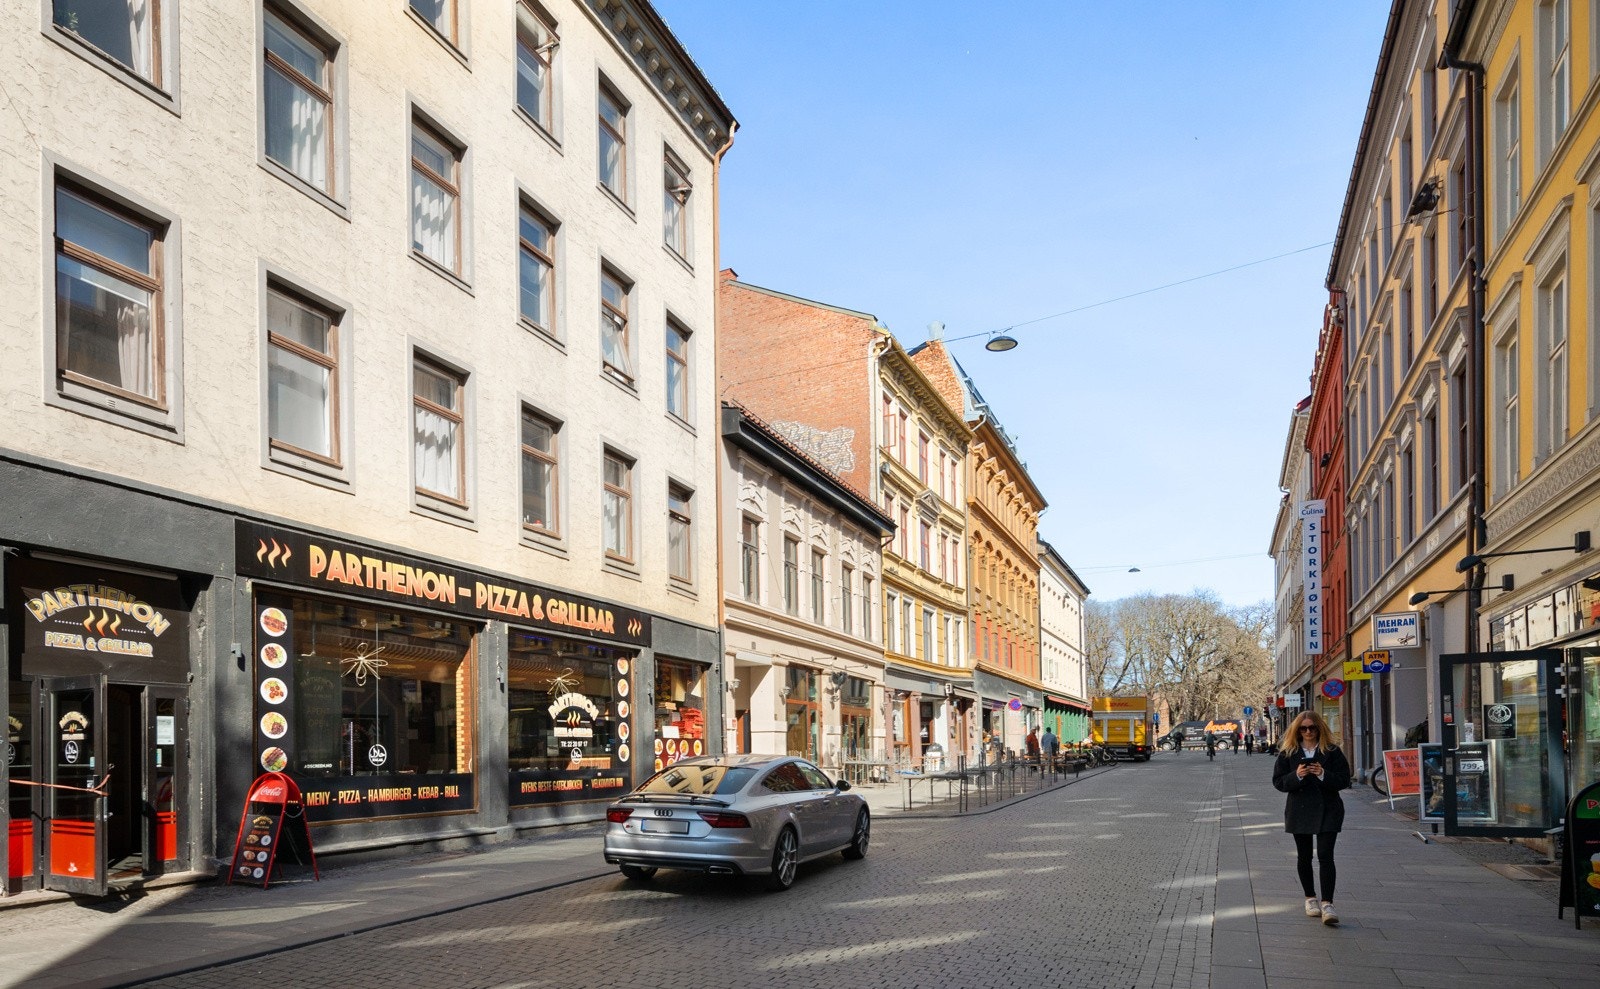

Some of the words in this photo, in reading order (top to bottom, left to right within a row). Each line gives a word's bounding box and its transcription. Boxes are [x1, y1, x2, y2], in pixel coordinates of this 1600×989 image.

[309, 544, 456, 604] PARTHENON
[476, 581, 530, 619] PIZZA
[532, 594, 545, 620] &
[546, 598, 615, 634] GRILLBAR
[1308, 522, 1319, 649] STORKJØKKEN
[25, 584, 171, 637] PARTHENON
[1378, 617, 1415, 628] MEHRAN
[45, 631, 85, 650] PIZZA
[86, 637, 98, 651] &
[98, 638, 153, 657] GRILLBAR
[1368, 652, 1385, 660] ATM
[306, 791, 331, 806] MENY
[338, 790, 361, 804] PIZZA
[368, 787, 412, 802] HAMBURGER
[418, 786, 439, 799] KEBAB
[444, 785, 460, 798] RULL
